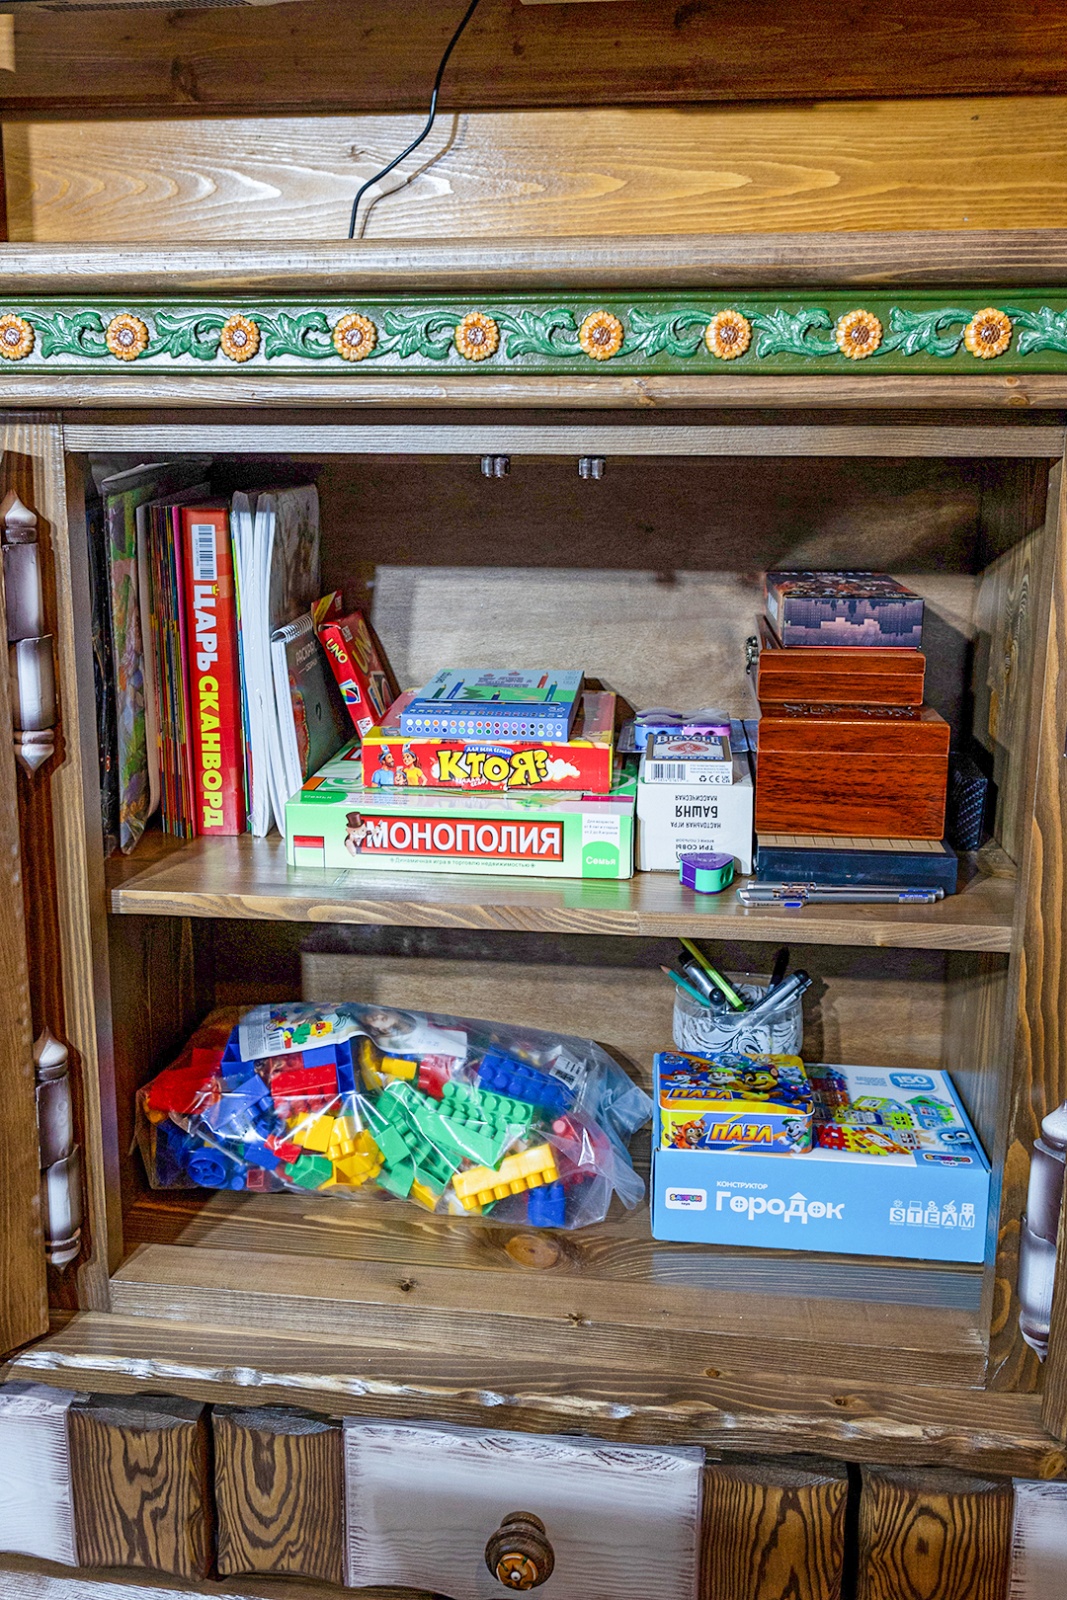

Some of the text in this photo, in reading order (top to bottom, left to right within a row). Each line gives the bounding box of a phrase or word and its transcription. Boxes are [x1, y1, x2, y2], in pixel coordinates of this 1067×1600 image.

[325, 637, 348, 664] UNO
[193, 585, 225, 828] ЦАРЬ СКАНВОРД
[656, 735, 721, 746] BICYCLE
[674, 794, 718, 802] КЛАССИЧЕСКАЯ
[675, 805, 719, 819] БАШНЯ
[669, 821, 722, 829] НАСТОЛЬНАЯ ИГРА
[366, 820, 561, 855] МОНОПОЛИЯ
[586, 856, 616, 866] Семья
[893, 1075, 928, 1084] 150
[671, 1088, 732, 1100] ПАЗЛ
[709, 1123, 772, 1144] ПАЗЛ
[716, 1180, 769, 1190] КОНСТРУКТОР
[891, 1208, 974, 1228] STEAM
